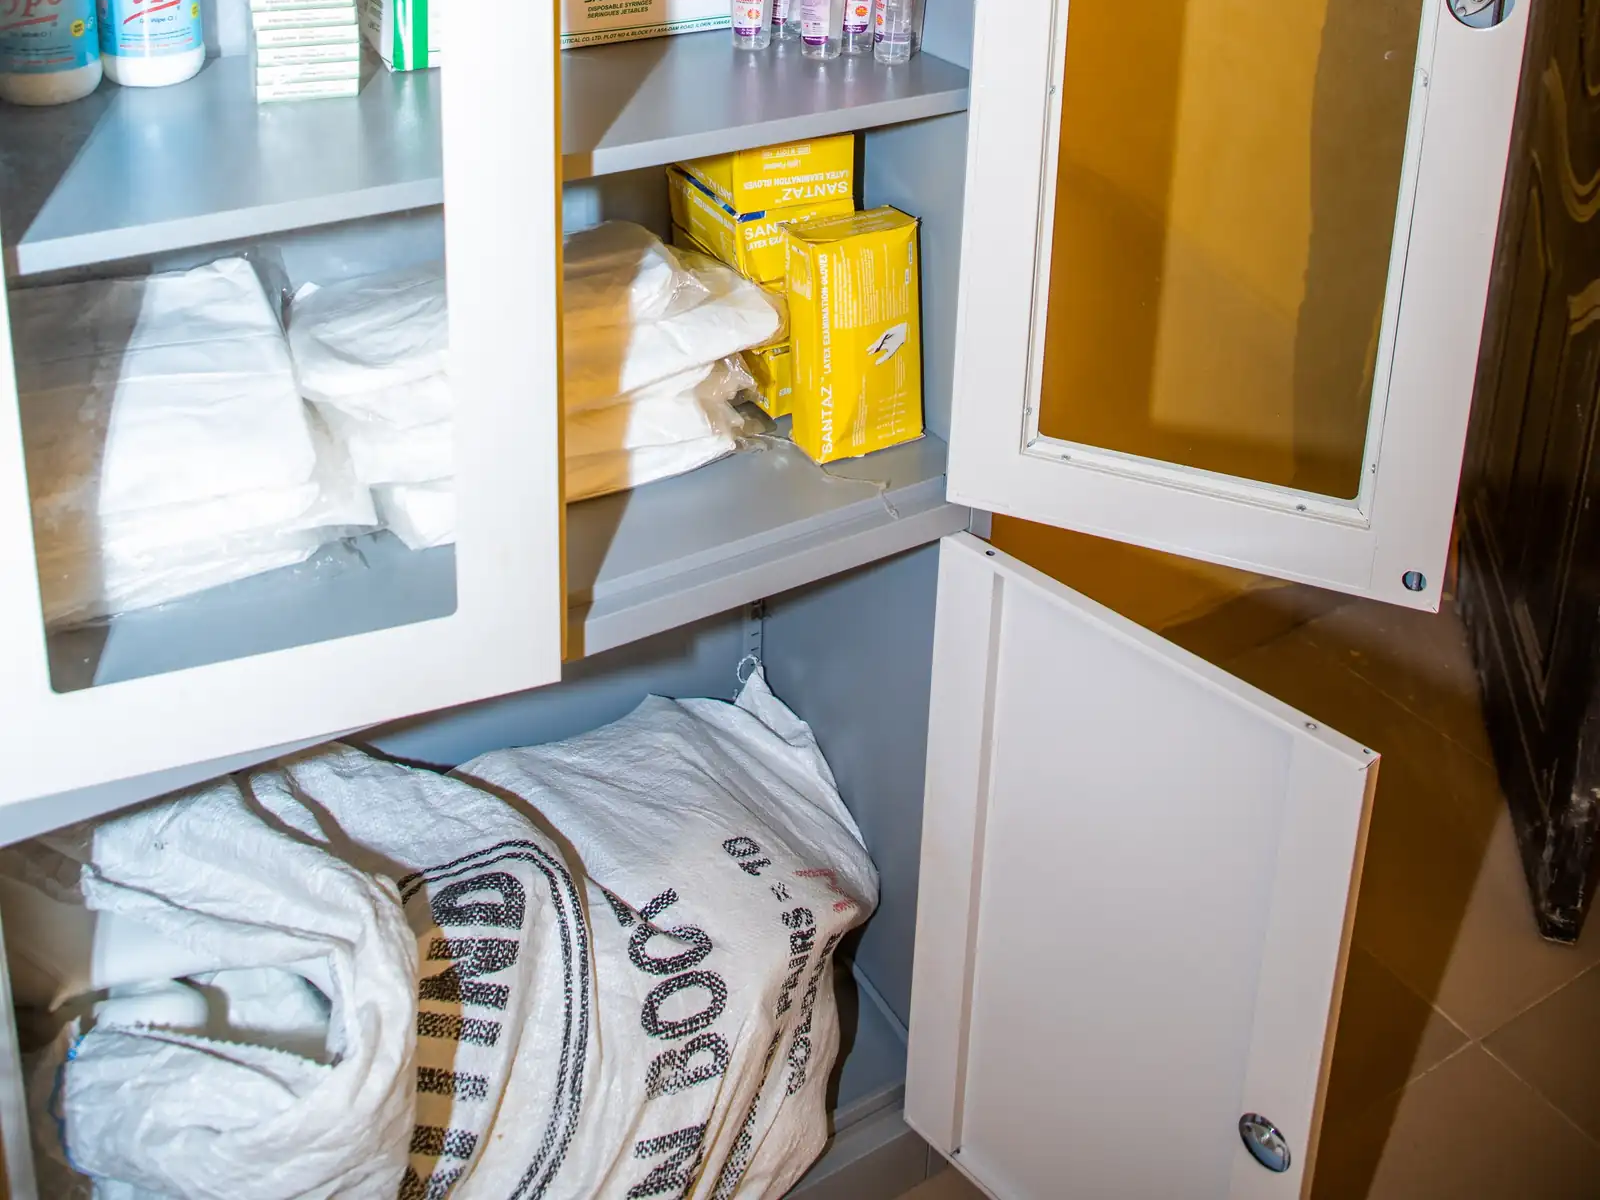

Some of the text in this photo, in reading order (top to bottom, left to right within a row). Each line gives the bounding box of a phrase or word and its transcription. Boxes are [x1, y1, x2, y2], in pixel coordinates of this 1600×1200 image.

[587, 6, 649, 19] SERINGUES JETABLES
[588, 0, 653, 12] DISPOSABLE SYRINGES
[743, 169, 849, 190] LATEX EXAMINATION GLOVES
[782, 181, 849, 201] SANTAZ
[818, 253, 833, 454] SANTAZ LATEX EXAMINATION GLOVES
[776, 907, 817, 1020] PAIRS
[600, 887, 730, 1100] BOOT
